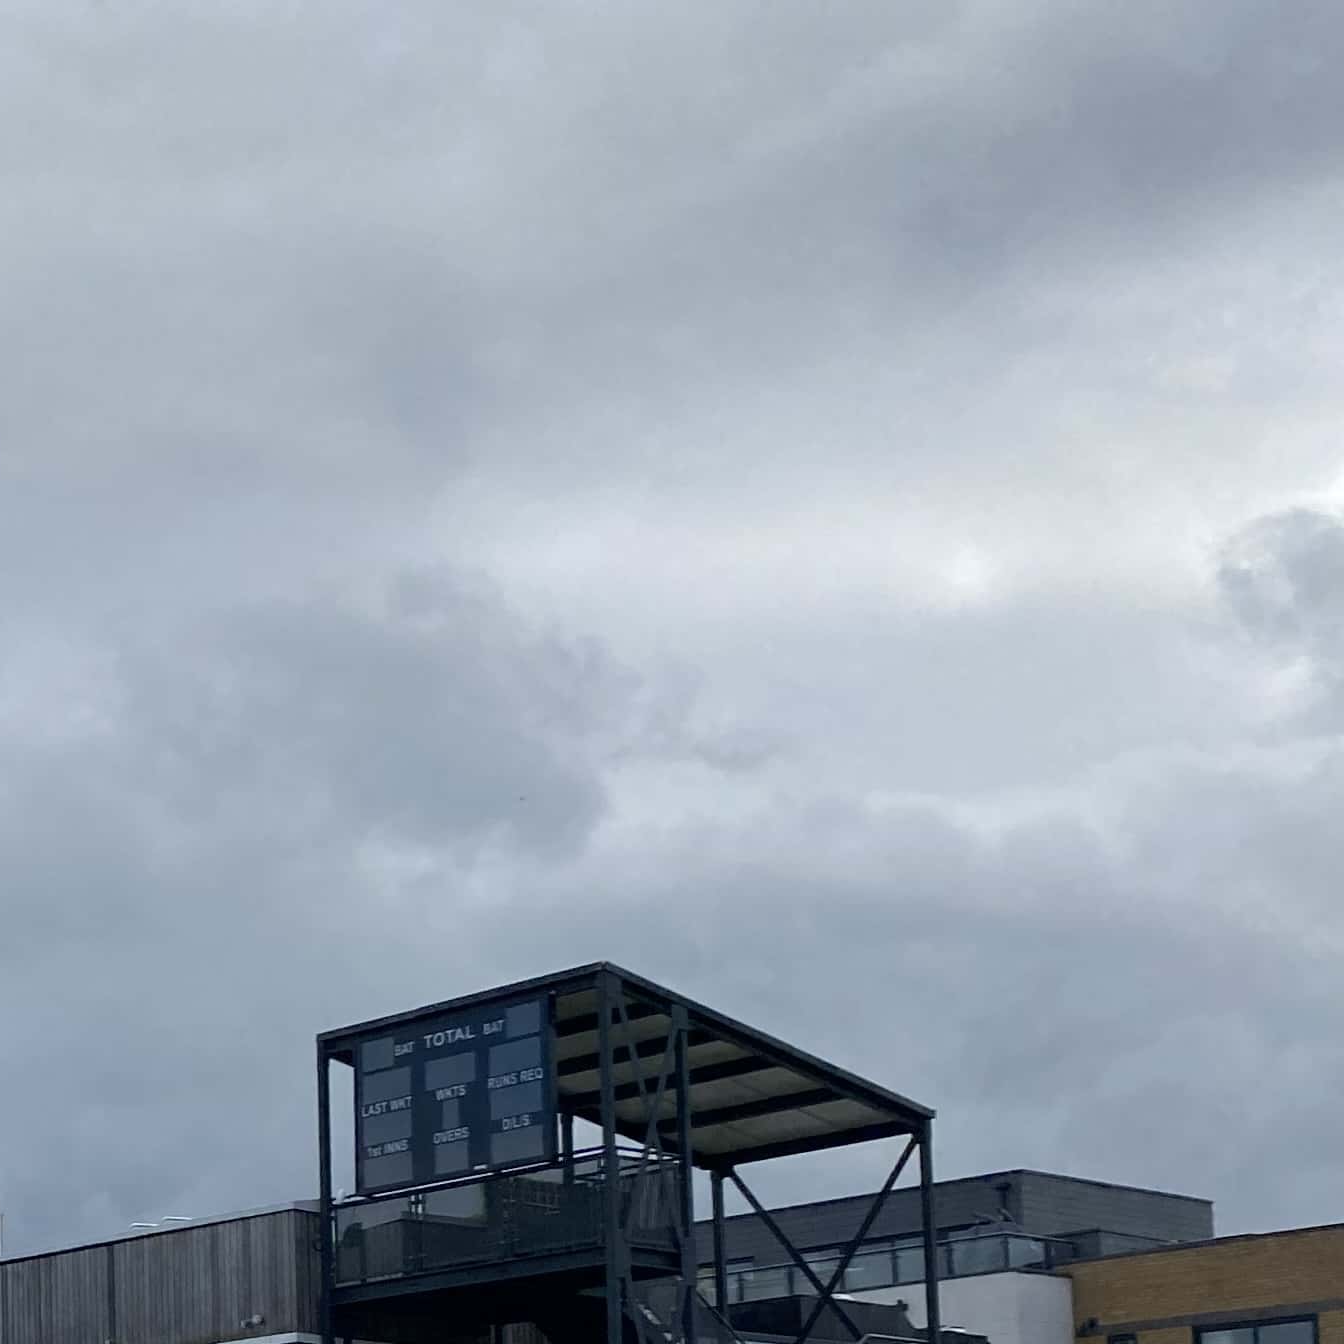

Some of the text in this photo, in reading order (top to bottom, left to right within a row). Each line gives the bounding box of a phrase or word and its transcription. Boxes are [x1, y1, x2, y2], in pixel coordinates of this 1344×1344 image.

[424, 1025, 477, 1049] TOTAL
[483, 1019, 505, 1035] BAT
[487, 1067, 544, 1089] RUNS REQ
[435, 1085, 467, 1101] WKTS
[361, 1096, 412, 1118] LAST WKT
[433, 1127, 470, 1144] OVERS
[383, 1139, 409, 1154] INNS
